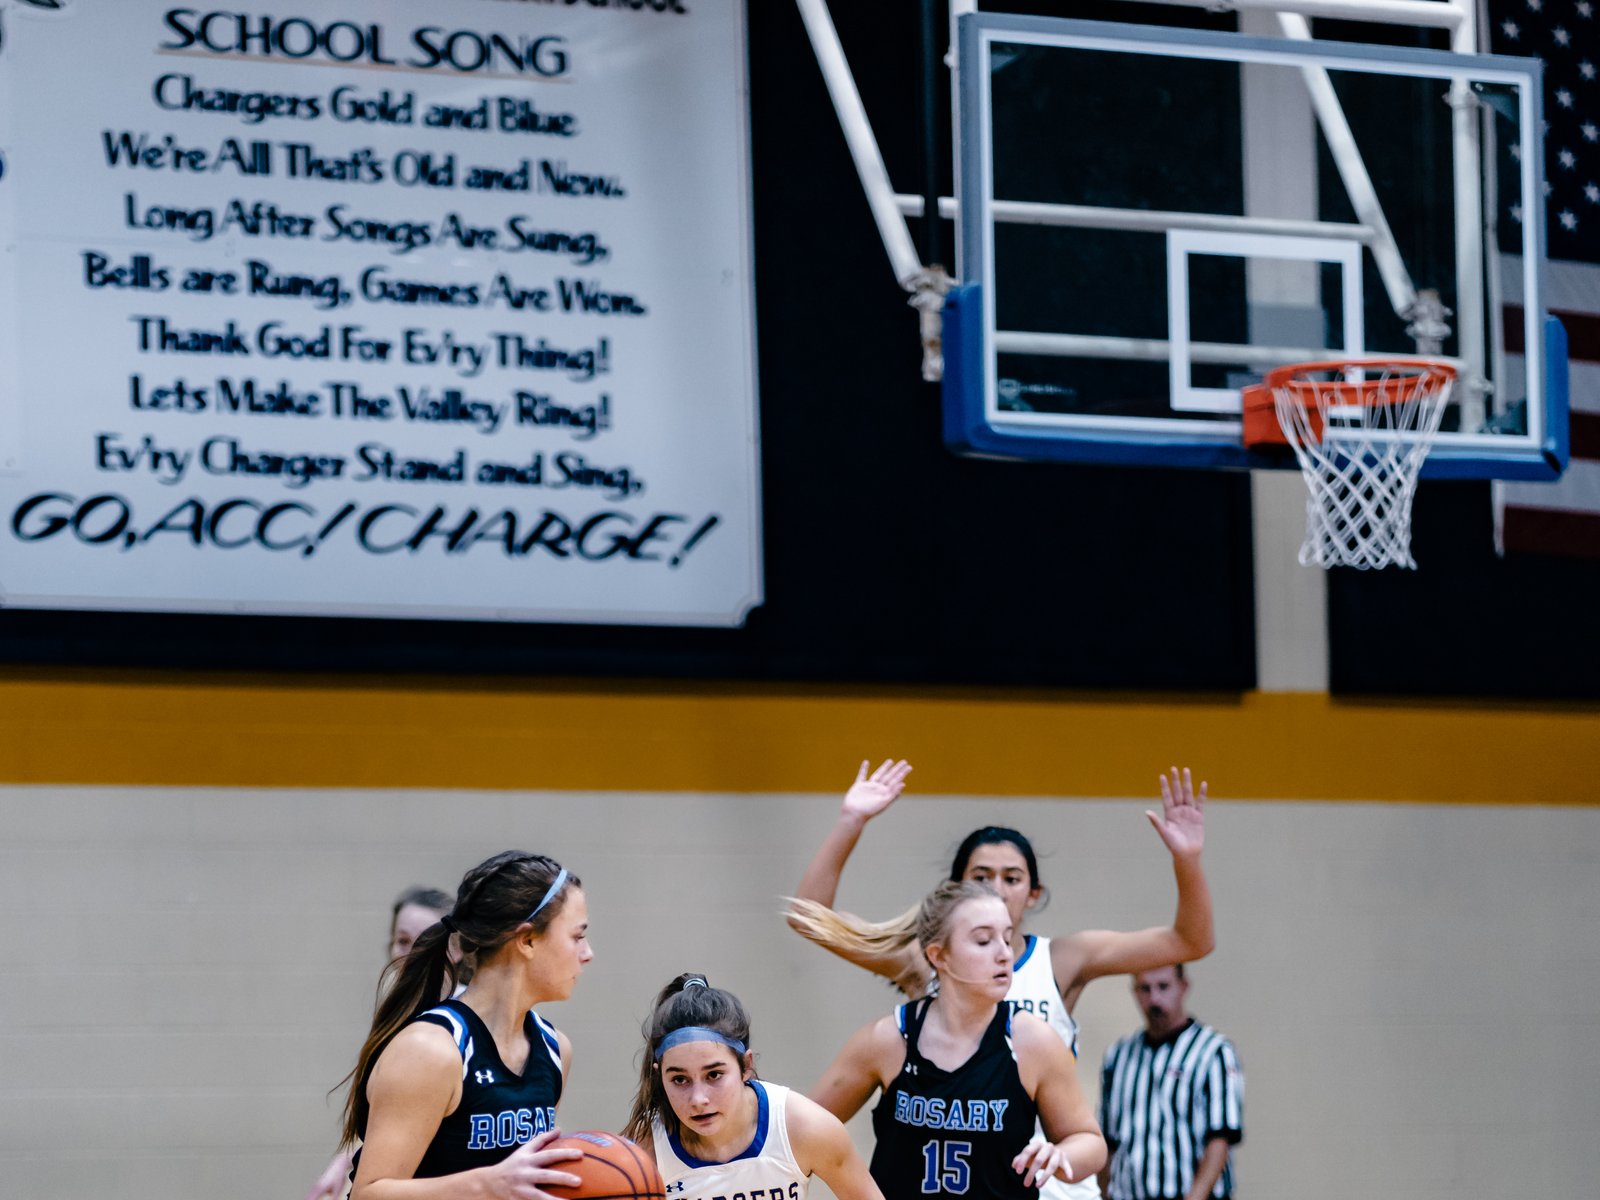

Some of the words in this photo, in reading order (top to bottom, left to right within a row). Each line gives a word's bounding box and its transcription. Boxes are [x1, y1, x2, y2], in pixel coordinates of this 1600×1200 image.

[161, 8, 398, 64] SCHOOL
[407, 27, 568, 76] SONG
[152, 73, 324, 125] Chargers
[328, 85, 415, 126] Gold
[422, 97, 492, 132] and
[495, 96, 578, 138] Blue
[101, 130, 208, 172] We're
[208, 137, 274, 176] All
[278, 142, 386, 184] That's
[391, 150, 457, 189] Old
[462, 158, 532, 193] and
[124, 192, 217, 242] Long
[217, 198, 317, 239] After
[322, 204, 436, 255] Songs
[436, 212, 500, 250] Are
[80, 250, 173, 292] Bells
[179, 268, 239, 295] are
[358, 265, 482, 308] Games
[483, 272, 552, 312] Are
[130, 315, 251, 356] Thank
[255, 321, 333, 360] God
[339, 324, 394, 363] For
[402, 328, 488, 378] Ev'ry
[491, 332, 611, 383] Thing!
[129, 373, 210, 414] Lets
[216, 376, 322, 418] Make
[324, 381, 395, 421] The
[396, 385, 506, 435] Valley
[512, 389, 612, 441] Ring!
[95, 433, 192, 486] Ev'ry
[199, 436, 348, 489] Charger
[354, 443, 467, 484] Stand
[474, 451, 546, 488] and
[357, 500, 722, 569] CHARGE!
[894, 1090, 1009, 1131] ROSARY
[921, 1139, 972, 1195] 15
